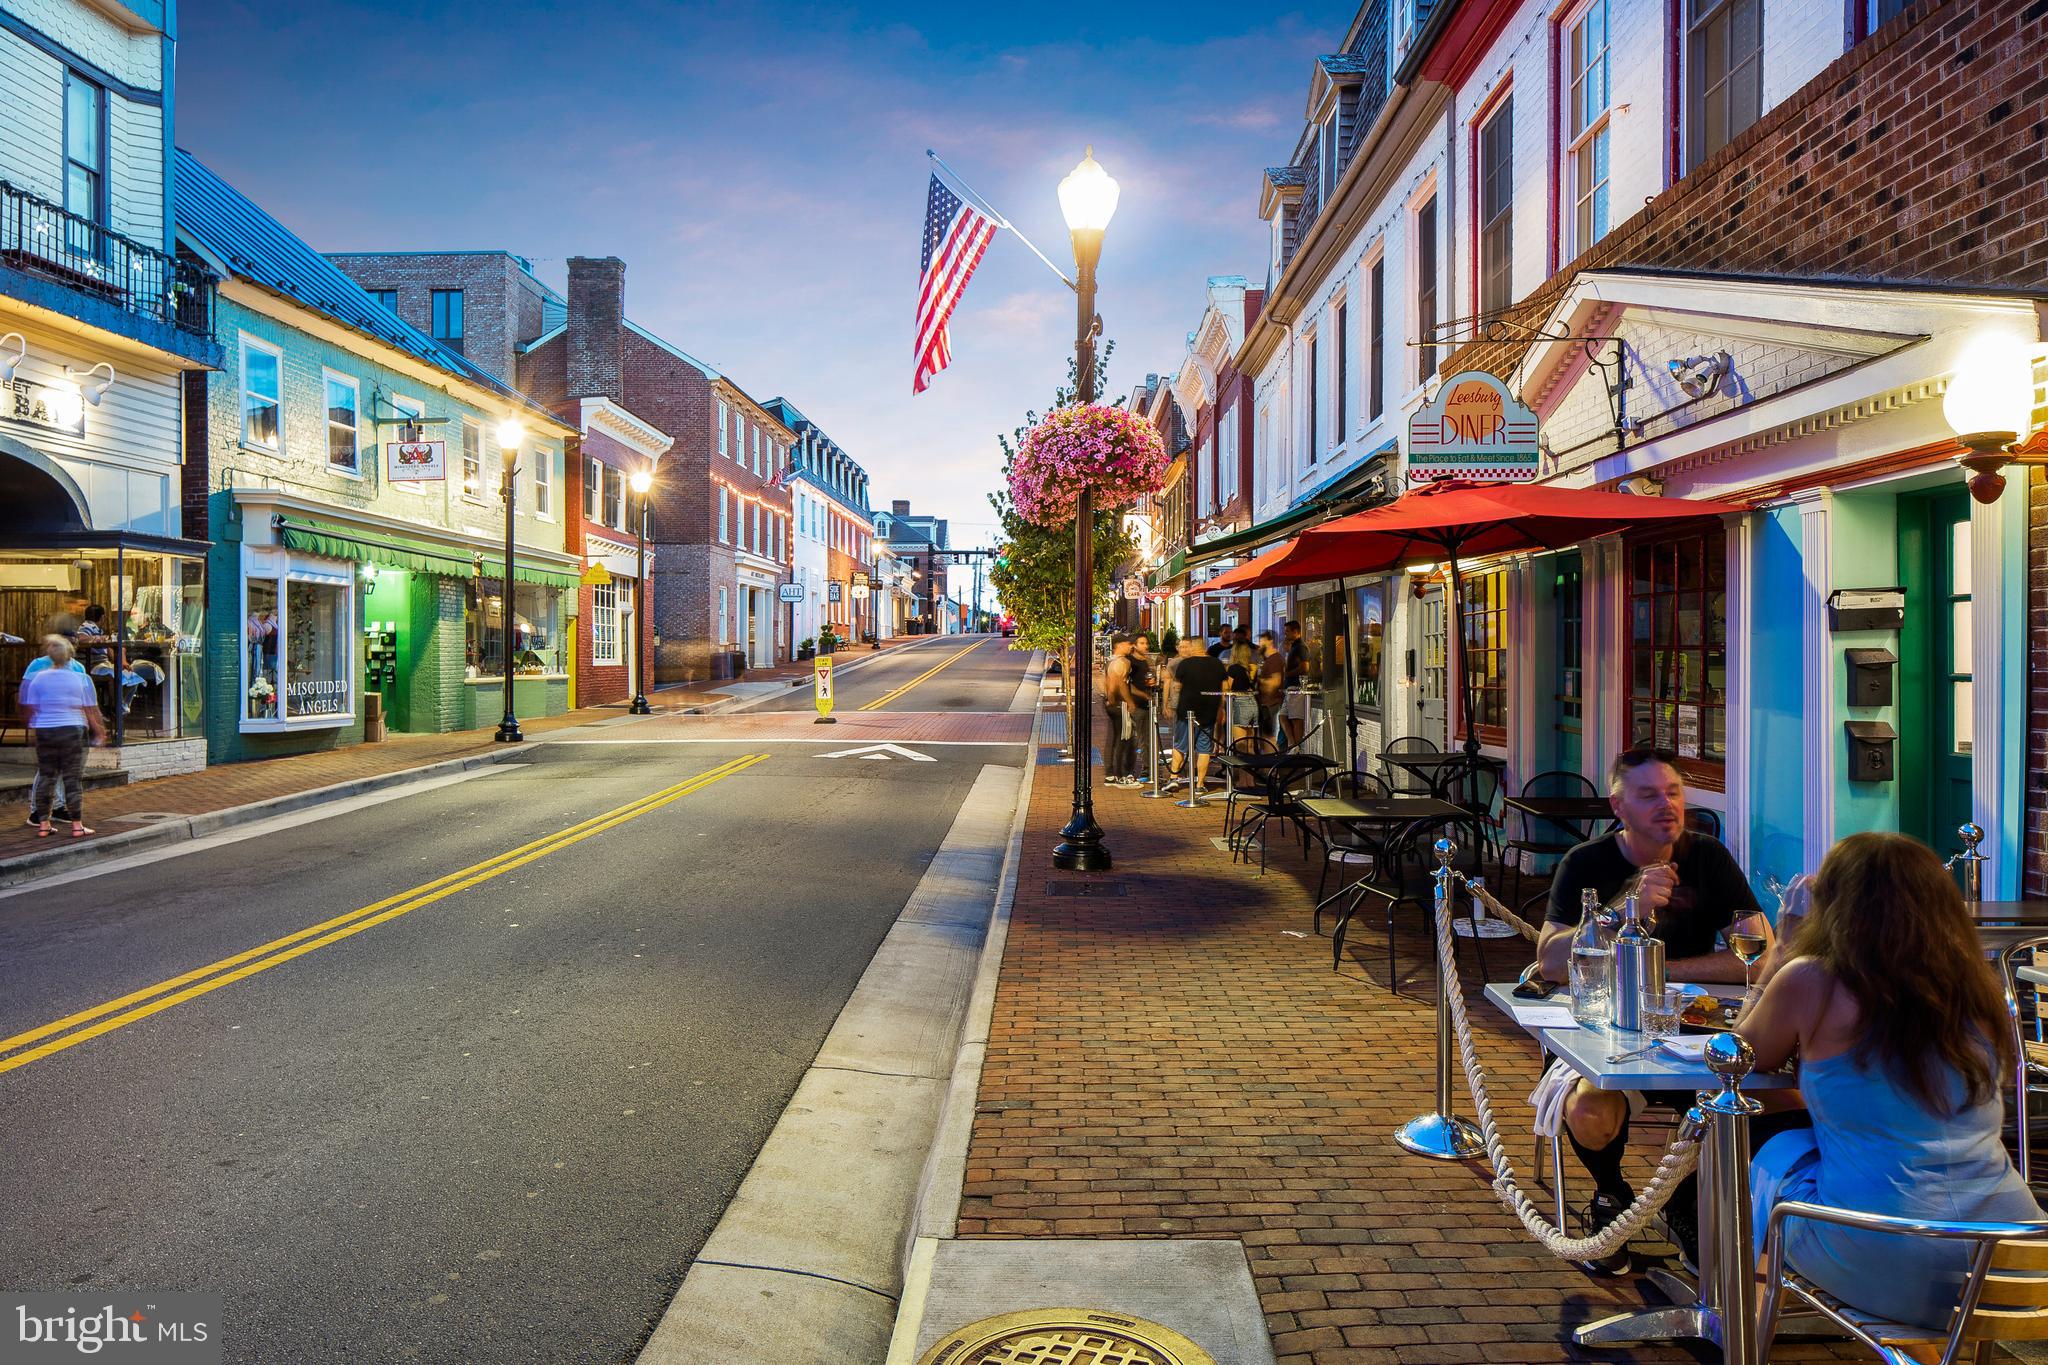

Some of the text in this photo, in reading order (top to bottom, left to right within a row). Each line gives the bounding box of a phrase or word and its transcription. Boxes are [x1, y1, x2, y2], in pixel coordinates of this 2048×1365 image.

[1448, 384, 1502, 411] Leesburg
[1441, 414, 1506, 445] DINER
[1416, 454, 1428, 462] The
[1429, 455, 1449, 463] Place
[1458, 454, 1470, 462] Eat
[1477, 454, 1495, 462] Meet
[1496, 454, 1514, 462] Since
[288, 680, 348, 696] MISGUIDED
[299, 699, 338, 715] ANGELS
